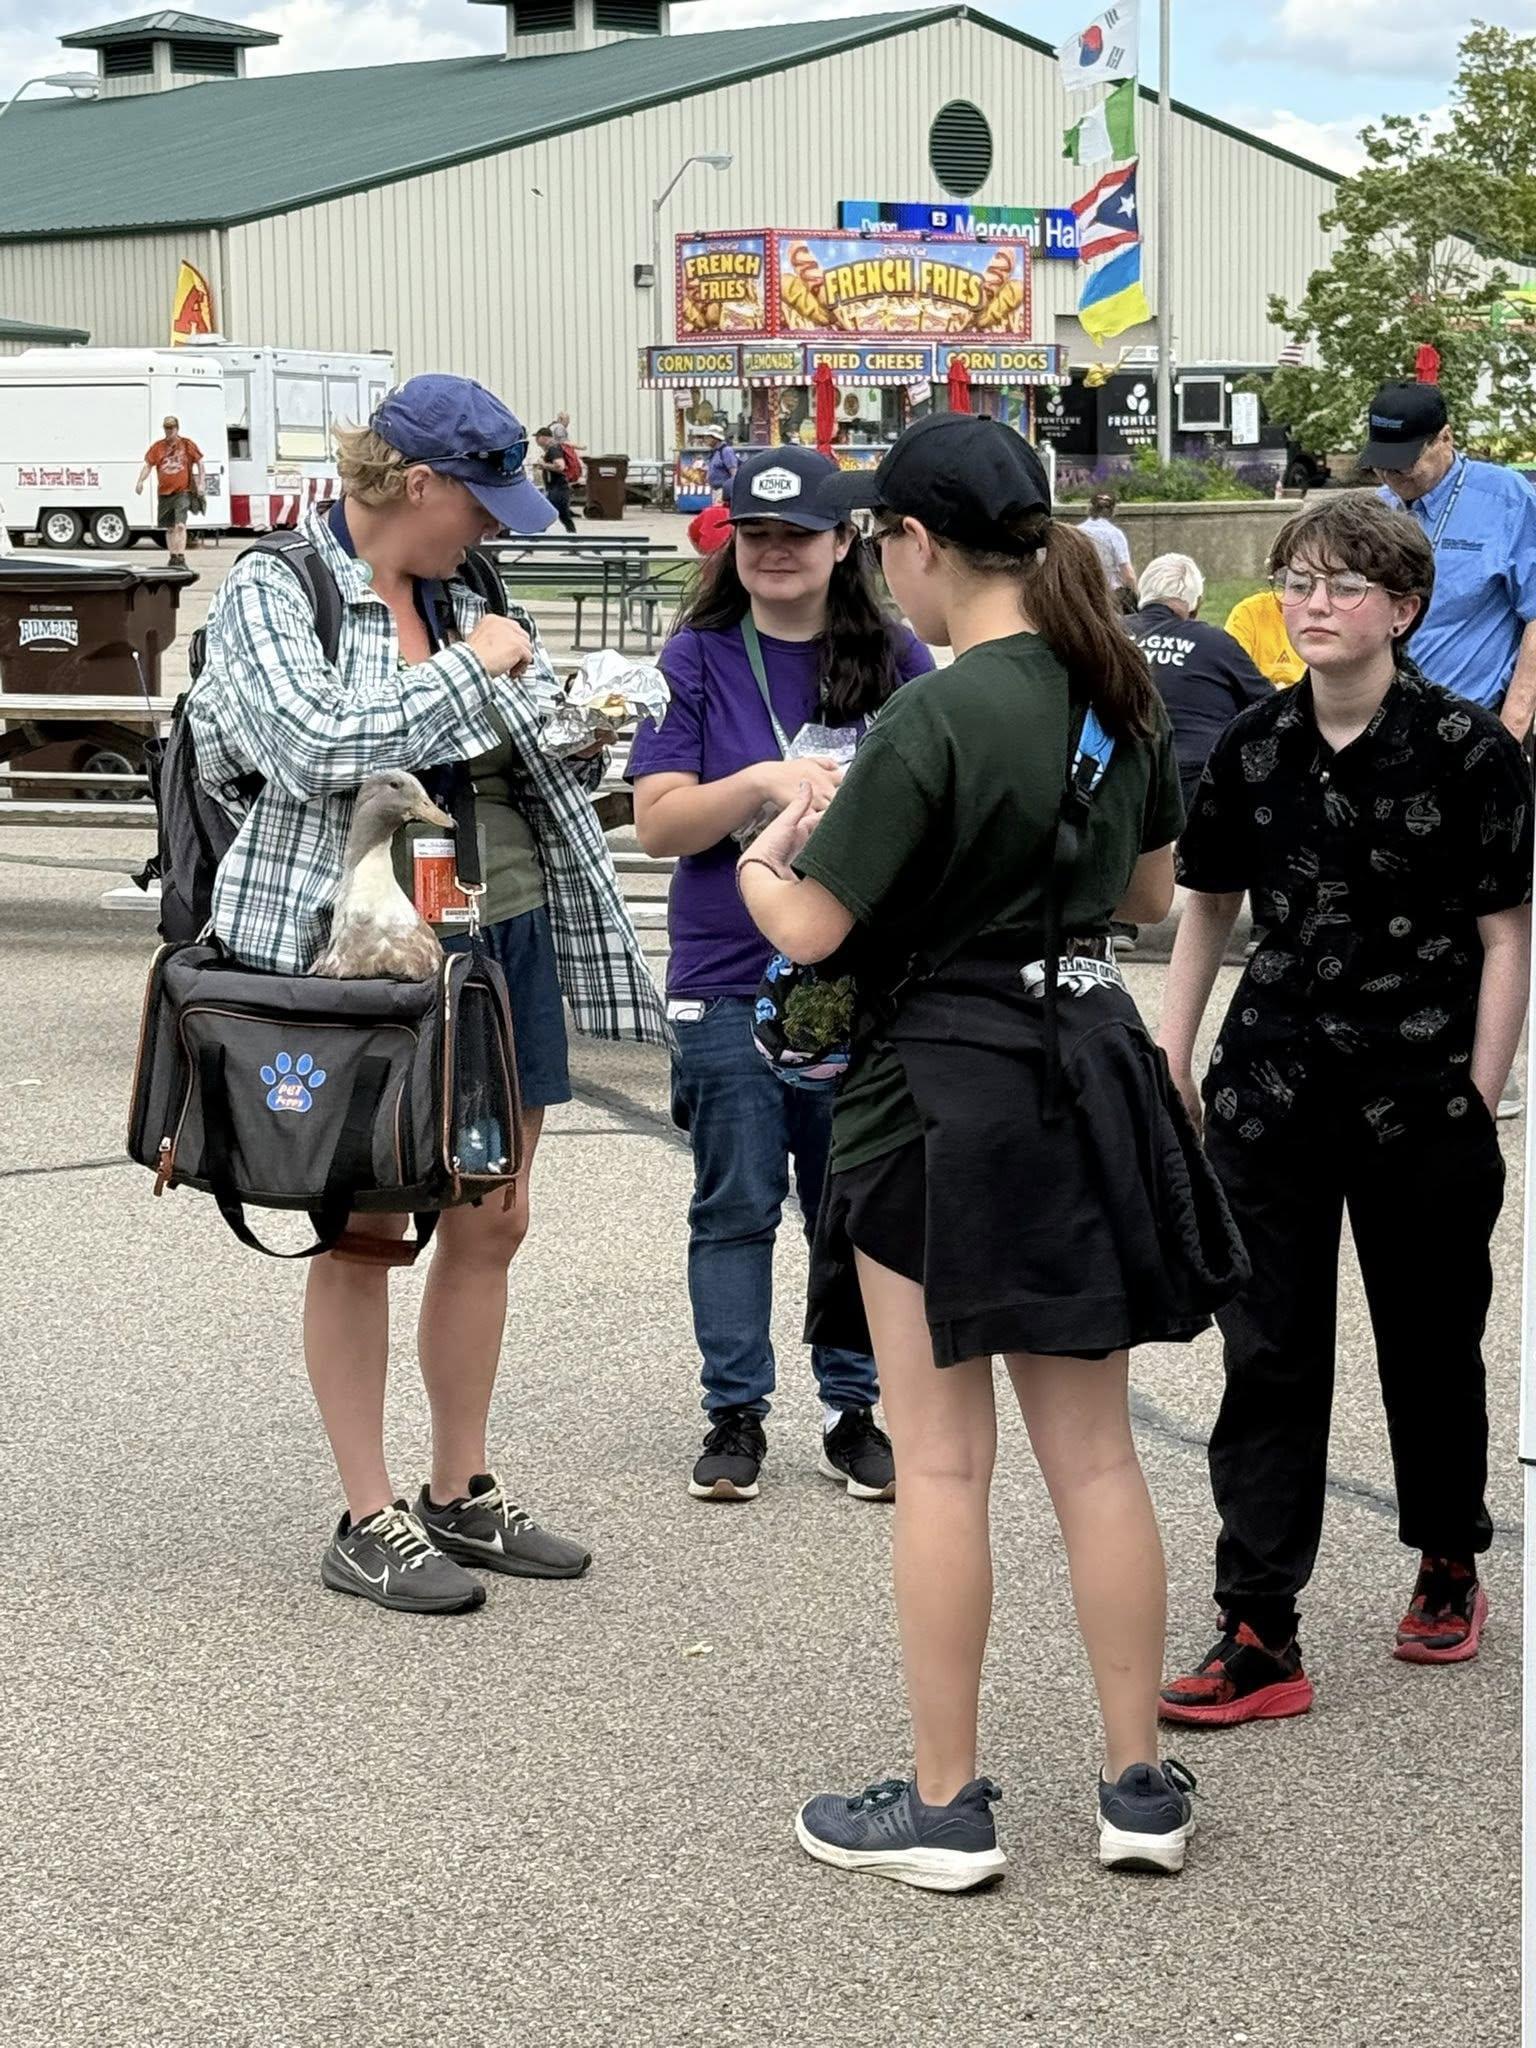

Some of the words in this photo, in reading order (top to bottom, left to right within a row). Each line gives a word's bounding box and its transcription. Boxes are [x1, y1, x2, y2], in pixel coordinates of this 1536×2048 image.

[955, 213, 1040, 247] Marconi
[1045, 217, 1080, 249] Hal
[685, 254, 760, 278] FRENCH
[700, 280, 746, 300] FRIES
[825, 259, 912, 304] FRENCH
[921, 261, 982, 307] FRIES
[656, 354, 693, 372] CORN
[697, 353, 733, 371] DOGS
[813, 353, 860, 369] FRIED
[865, 353, 925, 370] CHEESE
[1001, 353, 1048, 369] DOGS
[1107, 415, 1157, 427] FRONTLI
